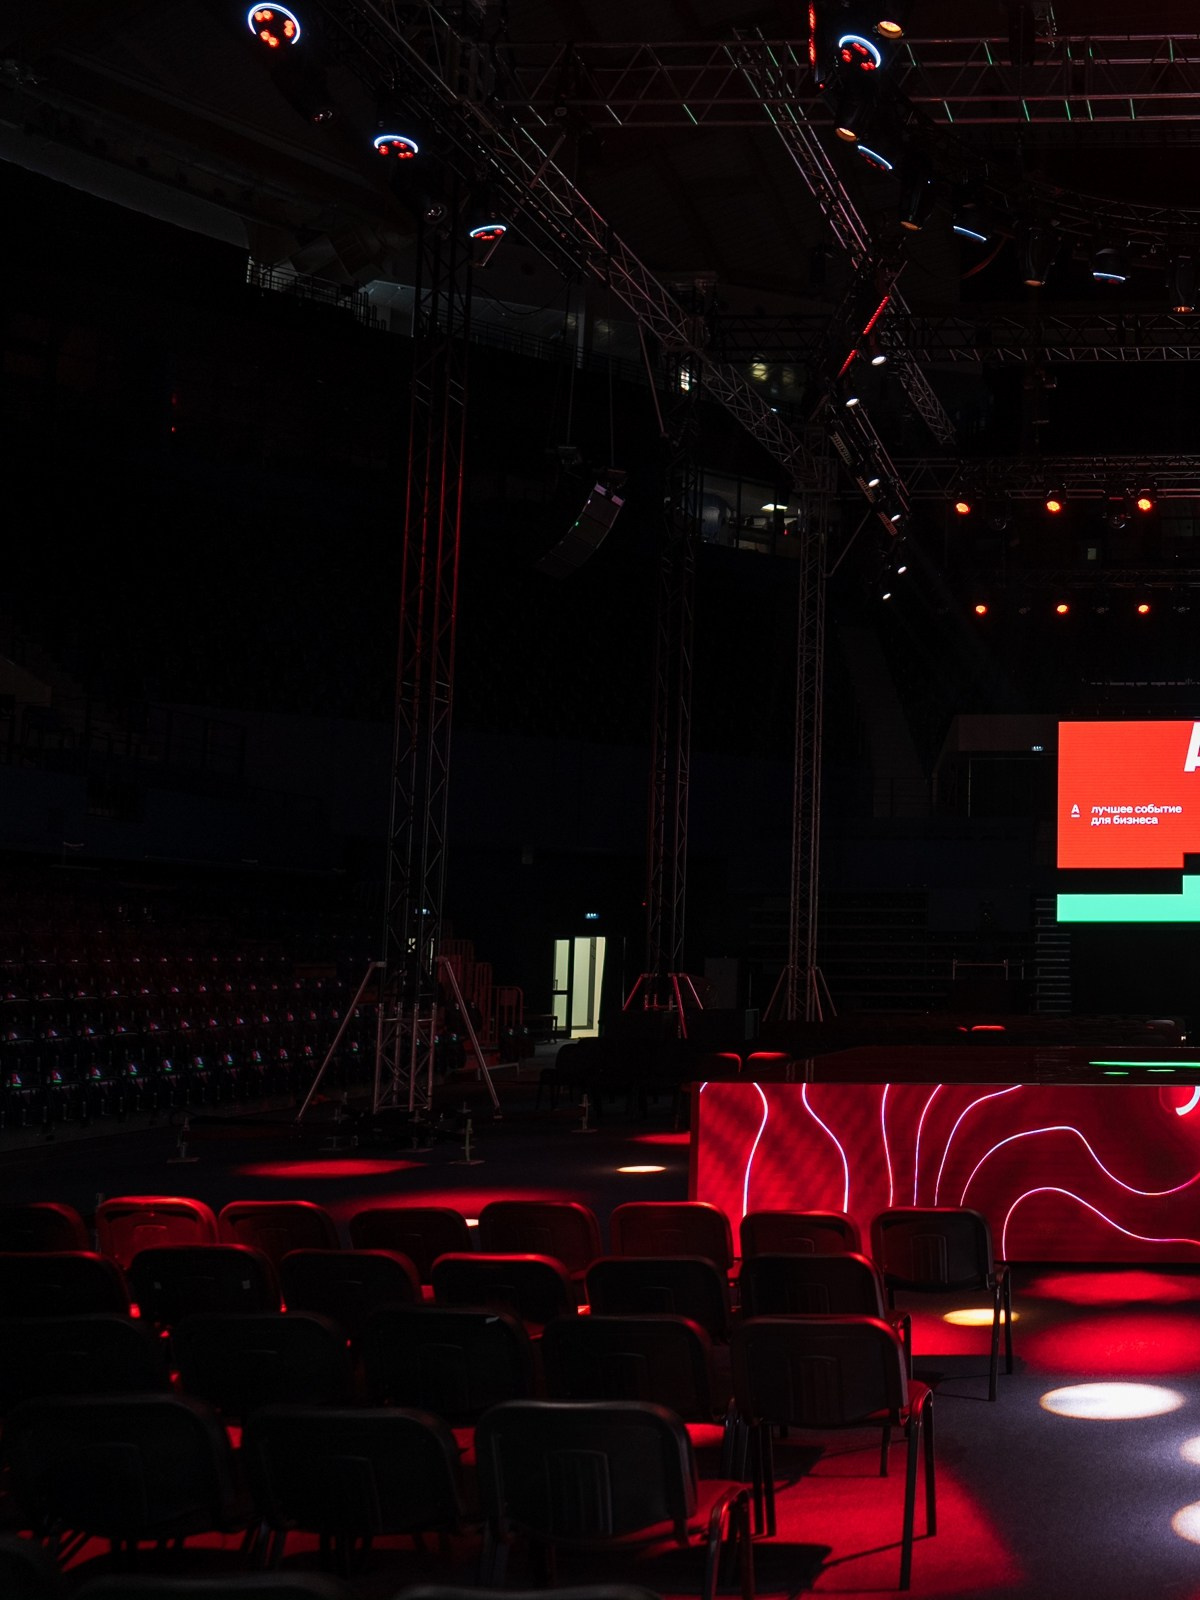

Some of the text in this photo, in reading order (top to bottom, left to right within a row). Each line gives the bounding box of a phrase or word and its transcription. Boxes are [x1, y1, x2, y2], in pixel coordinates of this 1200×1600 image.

[1091, 803, 1183, 816] лучшее событие
[1091, 815, 1159, 826] для бизнеса
